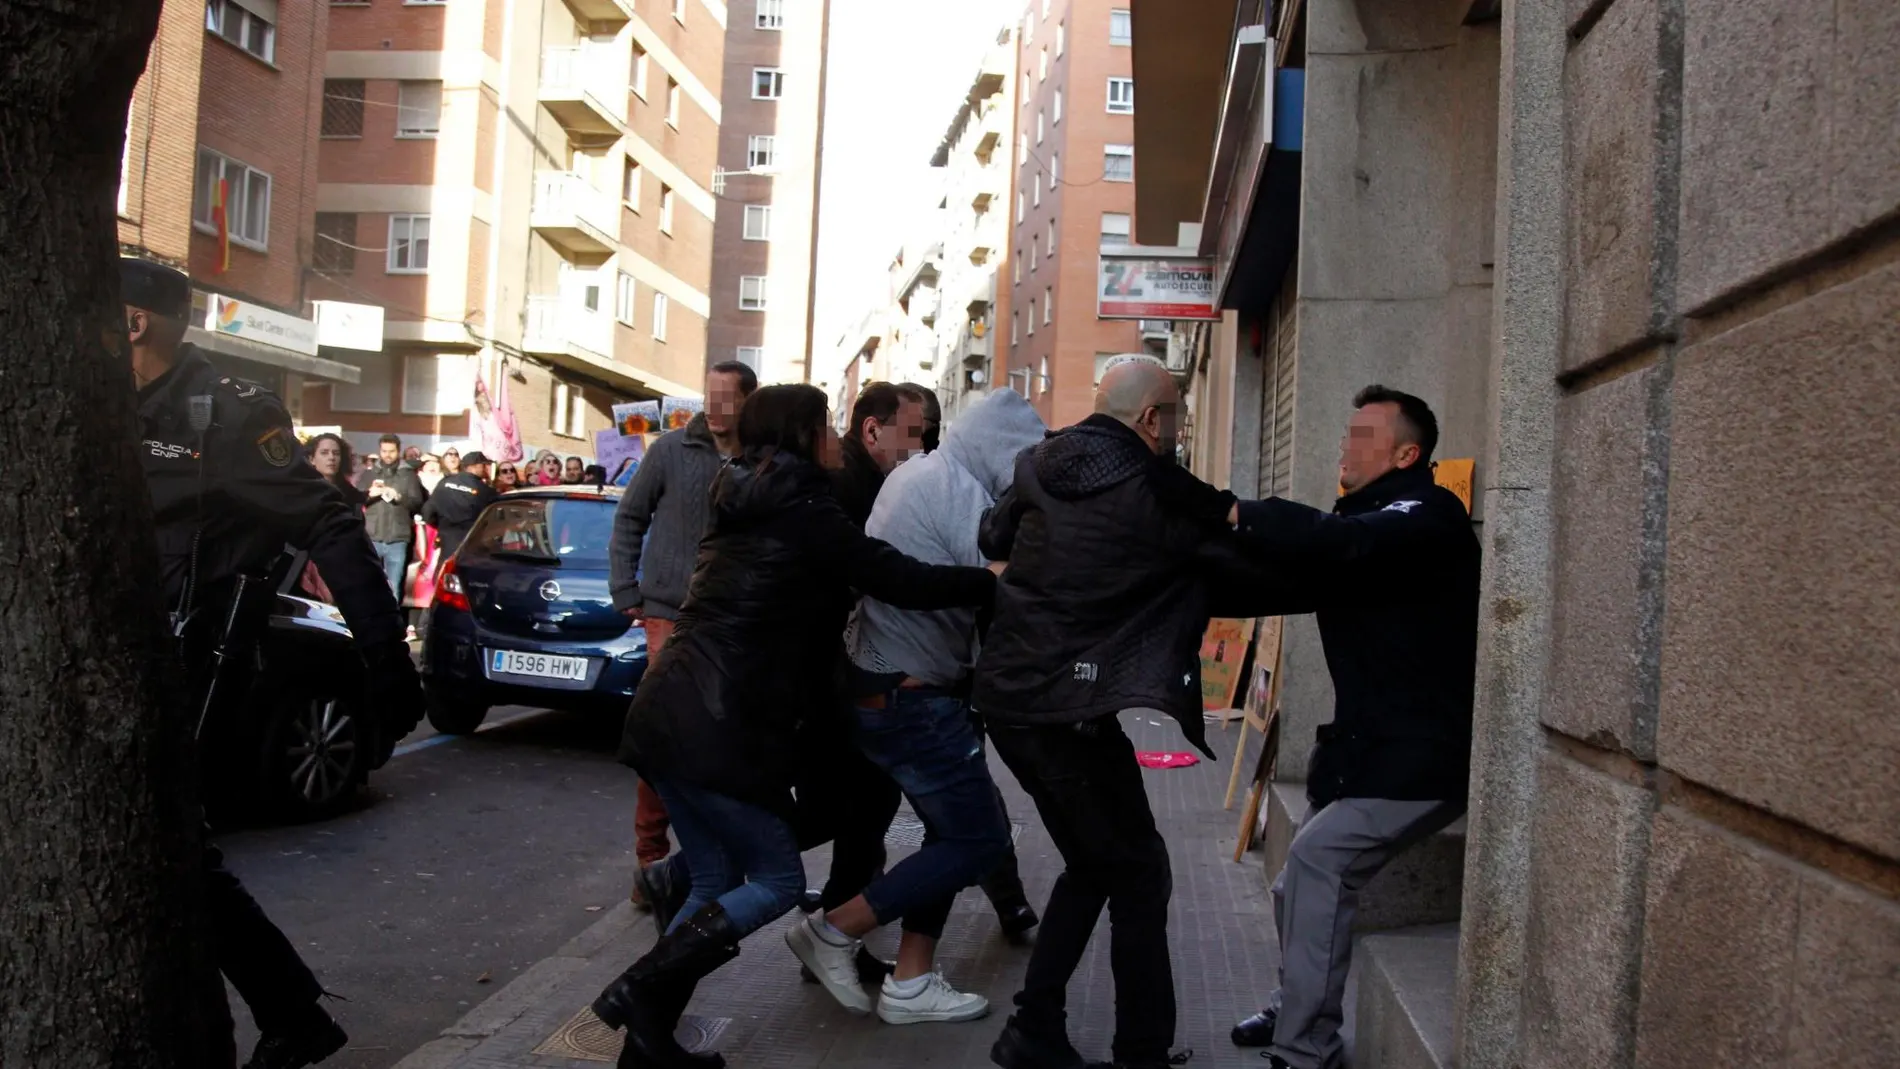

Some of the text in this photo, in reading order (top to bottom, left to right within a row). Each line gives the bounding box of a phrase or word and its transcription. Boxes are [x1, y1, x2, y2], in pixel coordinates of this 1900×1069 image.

[1153, 281, 1213, 291] AUTOESCUEL
[142, 439, 192, 456] POLICIA
[151, 448, 180, 459] CNP
[507, 654, 582, 677] 1596 HWV
